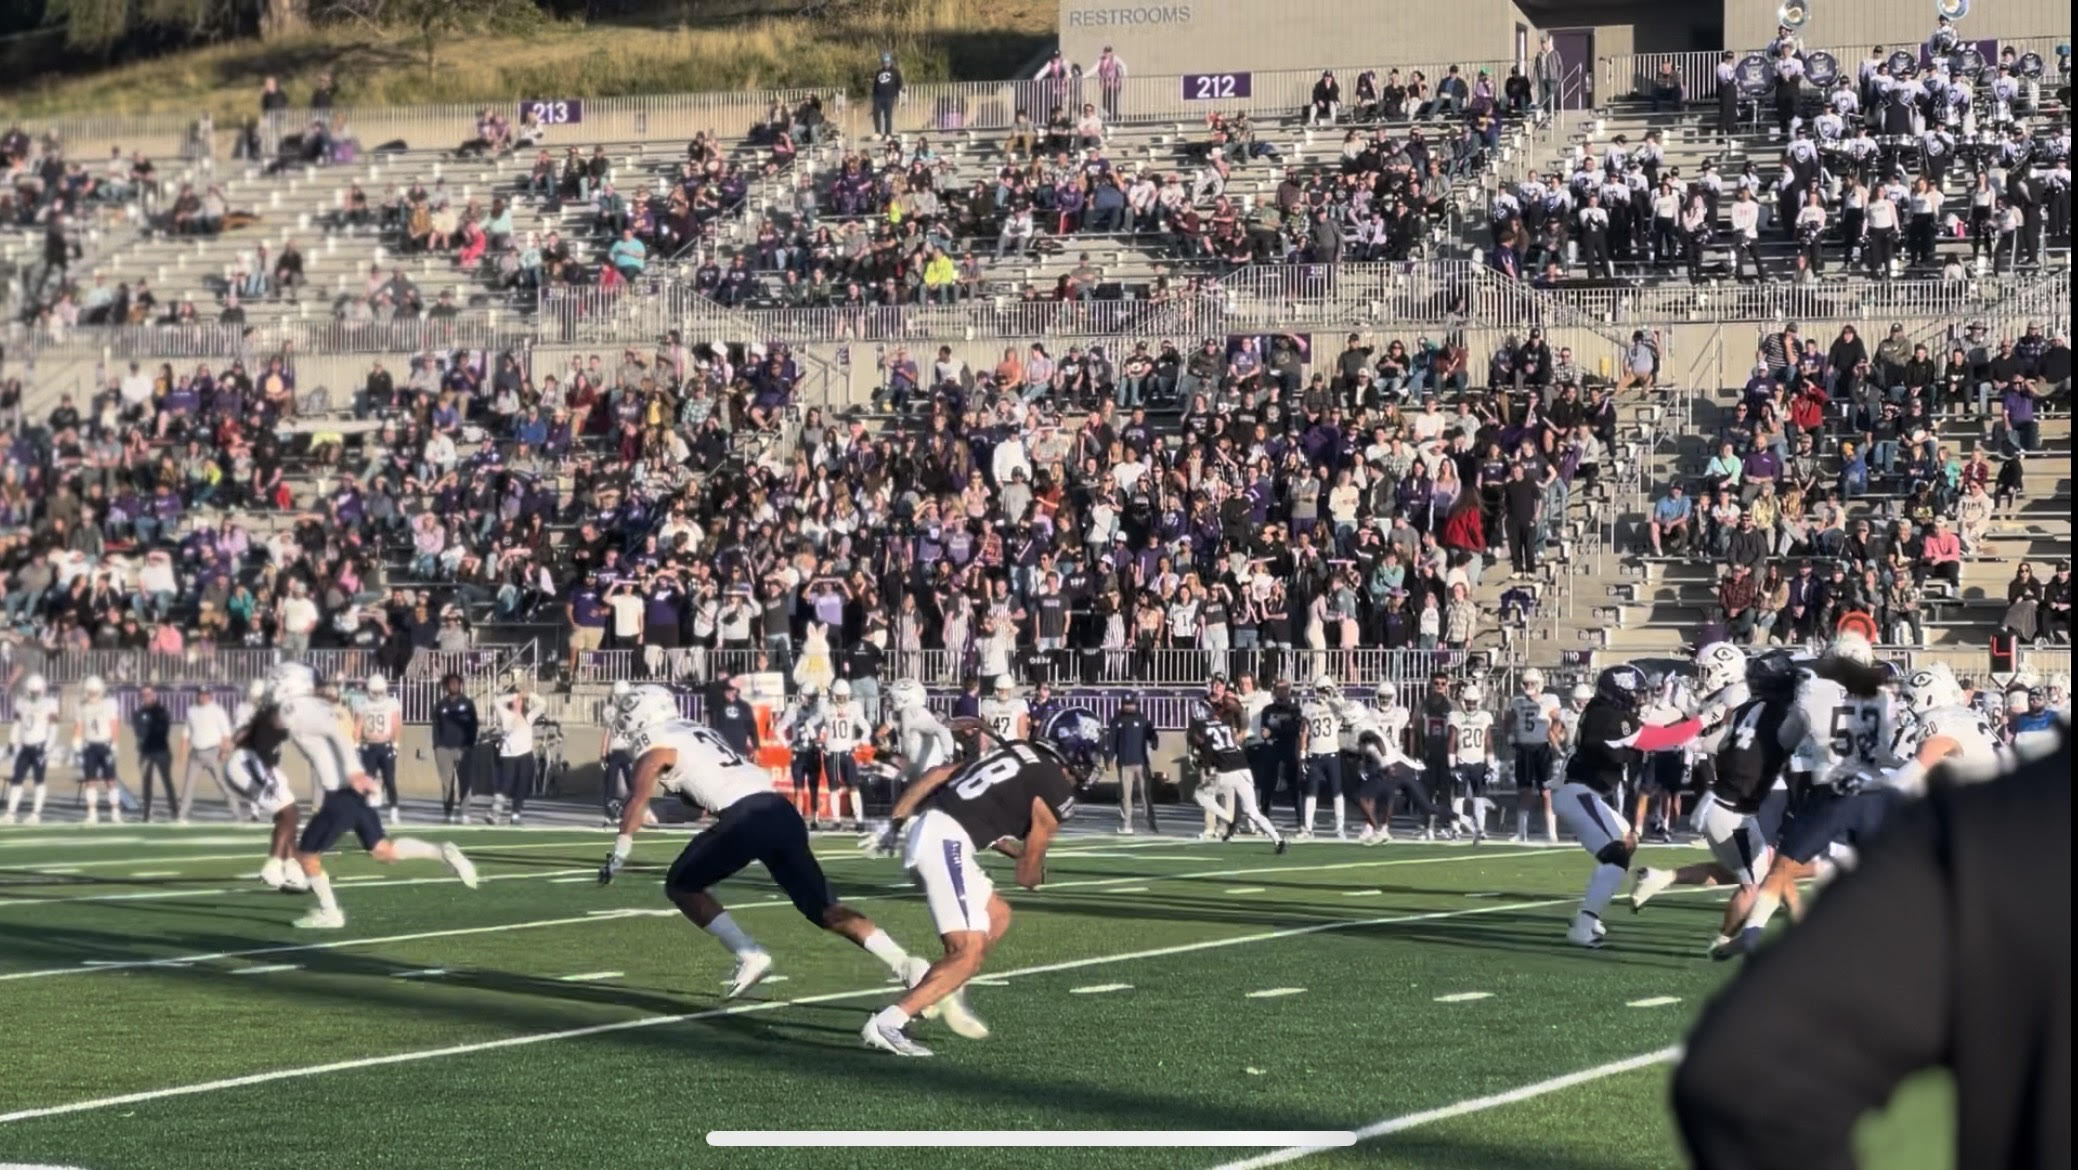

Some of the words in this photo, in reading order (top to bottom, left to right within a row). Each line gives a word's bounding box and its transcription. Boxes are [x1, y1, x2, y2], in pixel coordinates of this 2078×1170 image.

[1069, 6, 1191, 27] RESTROOMS
[1196, 75, 1236, 98] 212
[533, 102, 569, 124] 213
[1990, 634, 2017, 672] 4
[367, 713, 385, 733] 39
[832, 720, 848, 739] 10
[993, 717, 1010, 734] 47
[1312, 717, 1332, 738] 33
[1525, 711, 1535, 732] 5
[1923, 720, 1938, 737] 20
[1206, 725, 1235, 751] 37
[1463, 727, 1483, 749] 20
